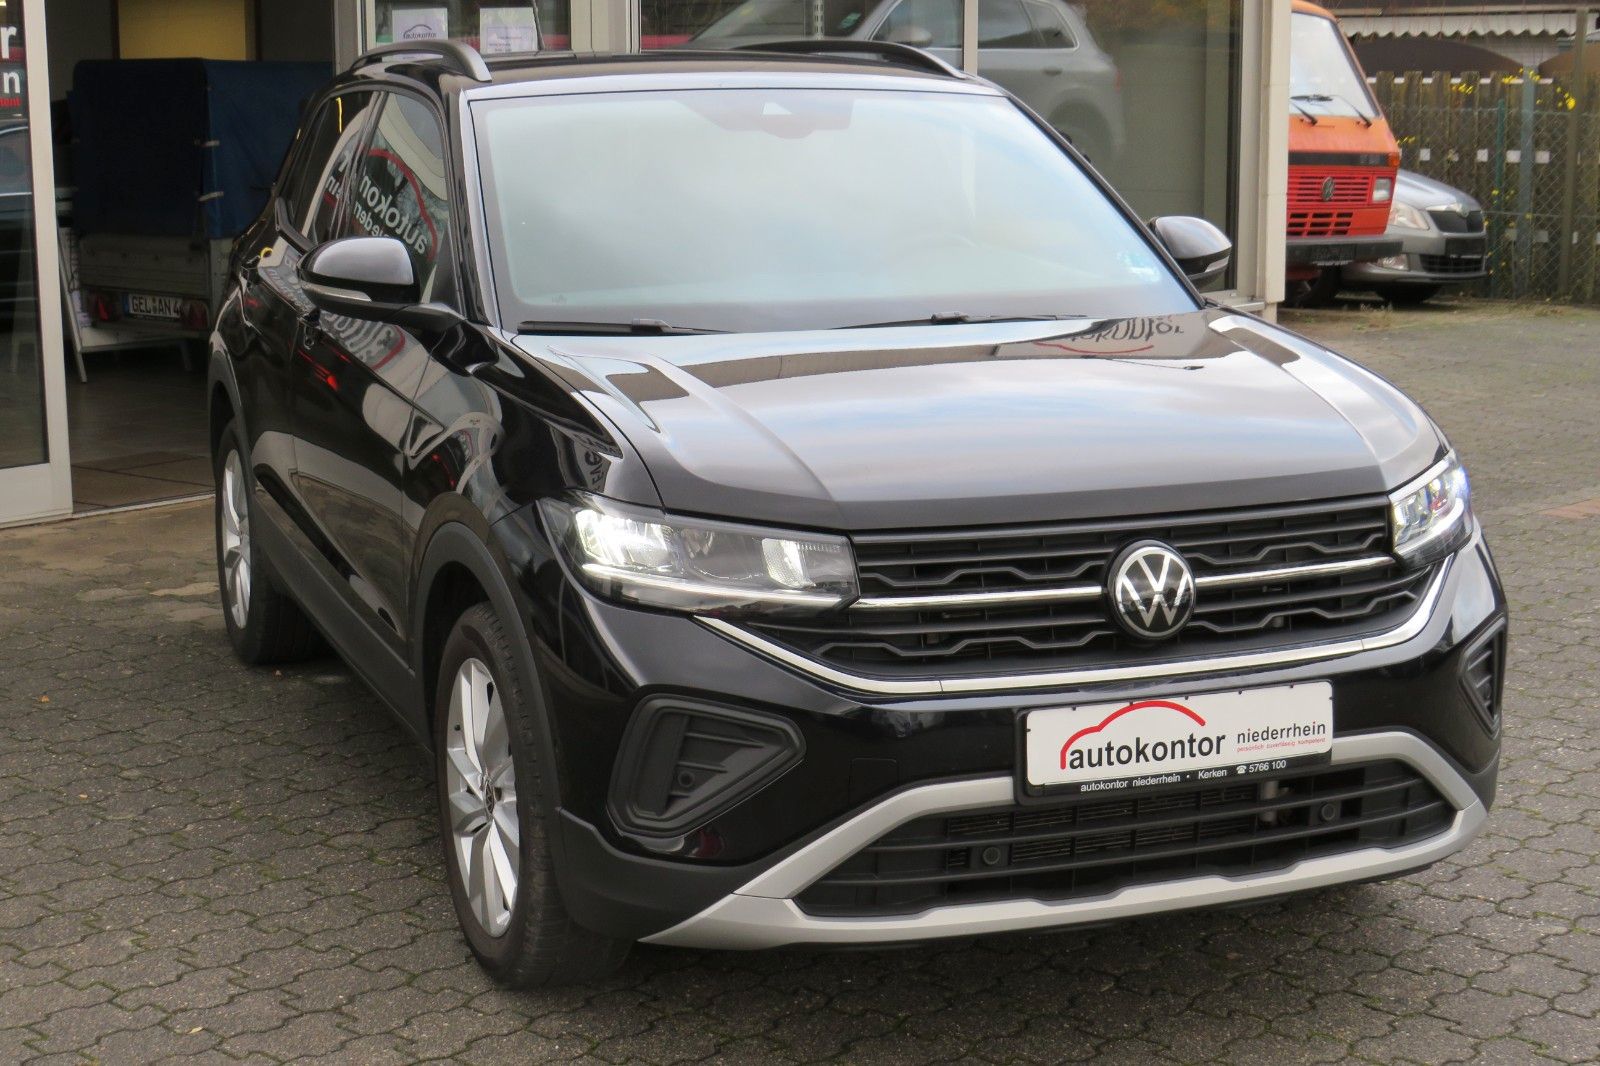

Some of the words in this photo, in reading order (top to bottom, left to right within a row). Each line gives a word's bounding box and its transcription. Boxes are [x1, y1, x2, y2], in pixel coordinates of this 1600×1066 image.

[1069, 733, 1226, 770] autokontor
[1237, 721, 1326, 744] niederrhein
[1080, 780, 1128, 792] autokontor
[1132, 773, 1181, 787] niederrhein
[1198, 769, 1227, 780] Kerken
[1248, 762, 1270, 773] 5766
[1271, 759, 1287, 770] 100
